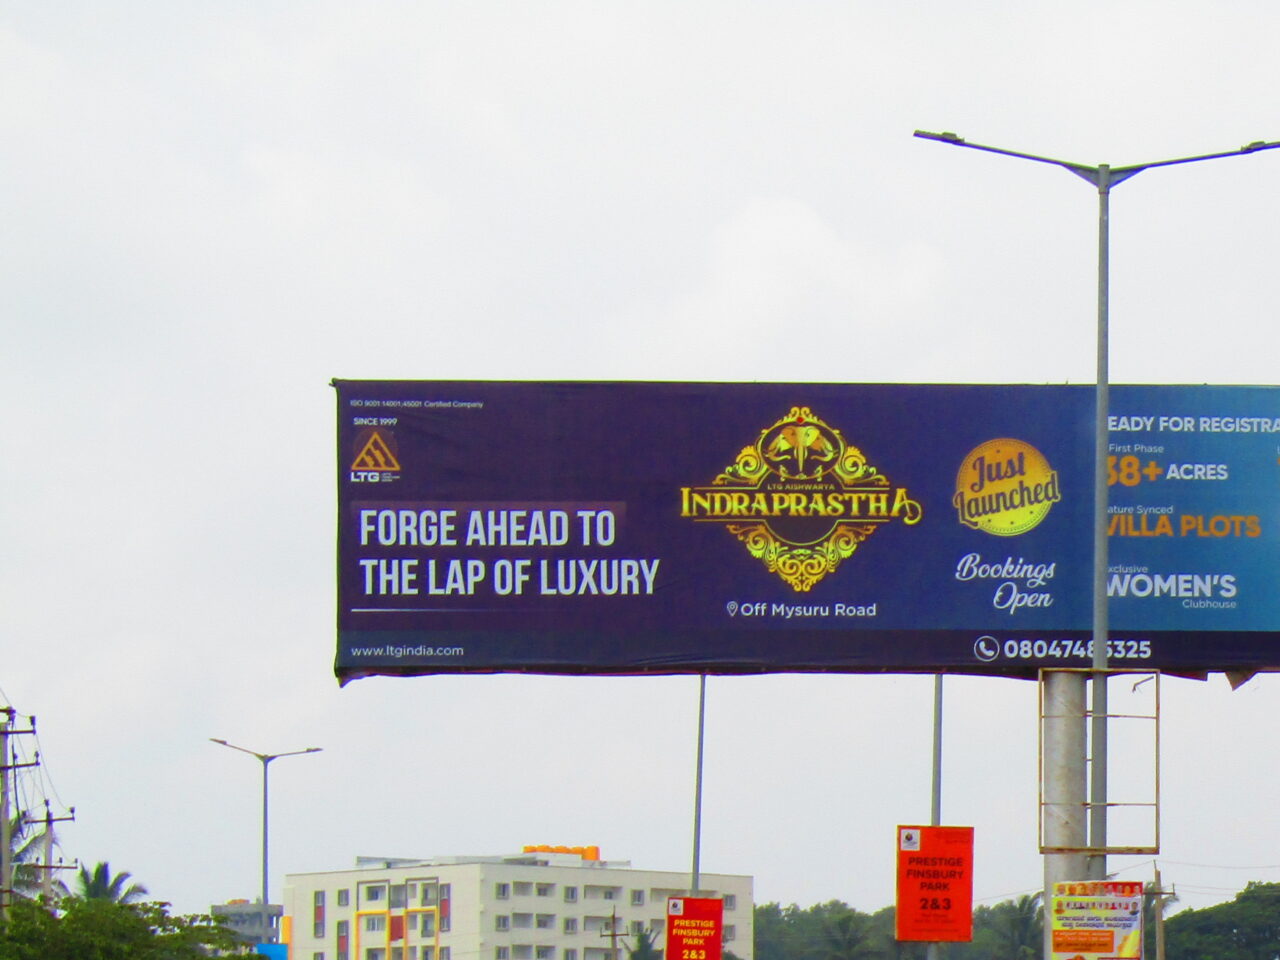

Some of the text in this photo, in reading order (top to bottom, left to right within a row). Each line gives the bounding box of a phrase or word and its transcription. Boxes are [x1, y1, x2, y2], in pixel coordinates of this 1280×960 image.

[452, 401, 483, 409] Company
[353, 417, 398, 426] SINCE 1999
[1107, 416, 1155, 431] EADY
[1159, 417, 1195, 432] FOR
[1108, 444, 1165, 453] First Phase
[351, 471, 379, 482] LTG
[970, 452, 1026, 493] Just
[1166, 464, 1229, 480] ACRES
[680, 487, 922, 525] INDRAPRASTHA
[954, 473, 1060, 527] Launched
[1107, 505, 1174, 515] ature Synced
[360, 509, 616, 546] FORGE AHEAD TO
[1181, 515, 1262, 538] PLOTS
[955, 553, 1056, 588] Bookings
[1108, 565, 1149, 574] xclusive
[359, 559, 660, 595] THE LAP OF LUXURY
[1107, 574, 1237, 597] WOMEN'S
[993, 581, 1054, 615] Open
[1182, 599, 1237, 609] Clubhouse
[740, 603, 876, 619] Off Mysuru Road
[351, 645, 464, 657] www.ltgindia.com
[908, 857, 963, 867] PRESTIGE
[906, 869, 964, 879] FINSBURY
[919, 881, 950, 891] PARK
[919, 898, 952, 910] 2&3
[674, 919, 715, 928] PRESTIGE
[672, 928, 715, 937] FINSBURY
[682, 949, 706, 960] 2&3
